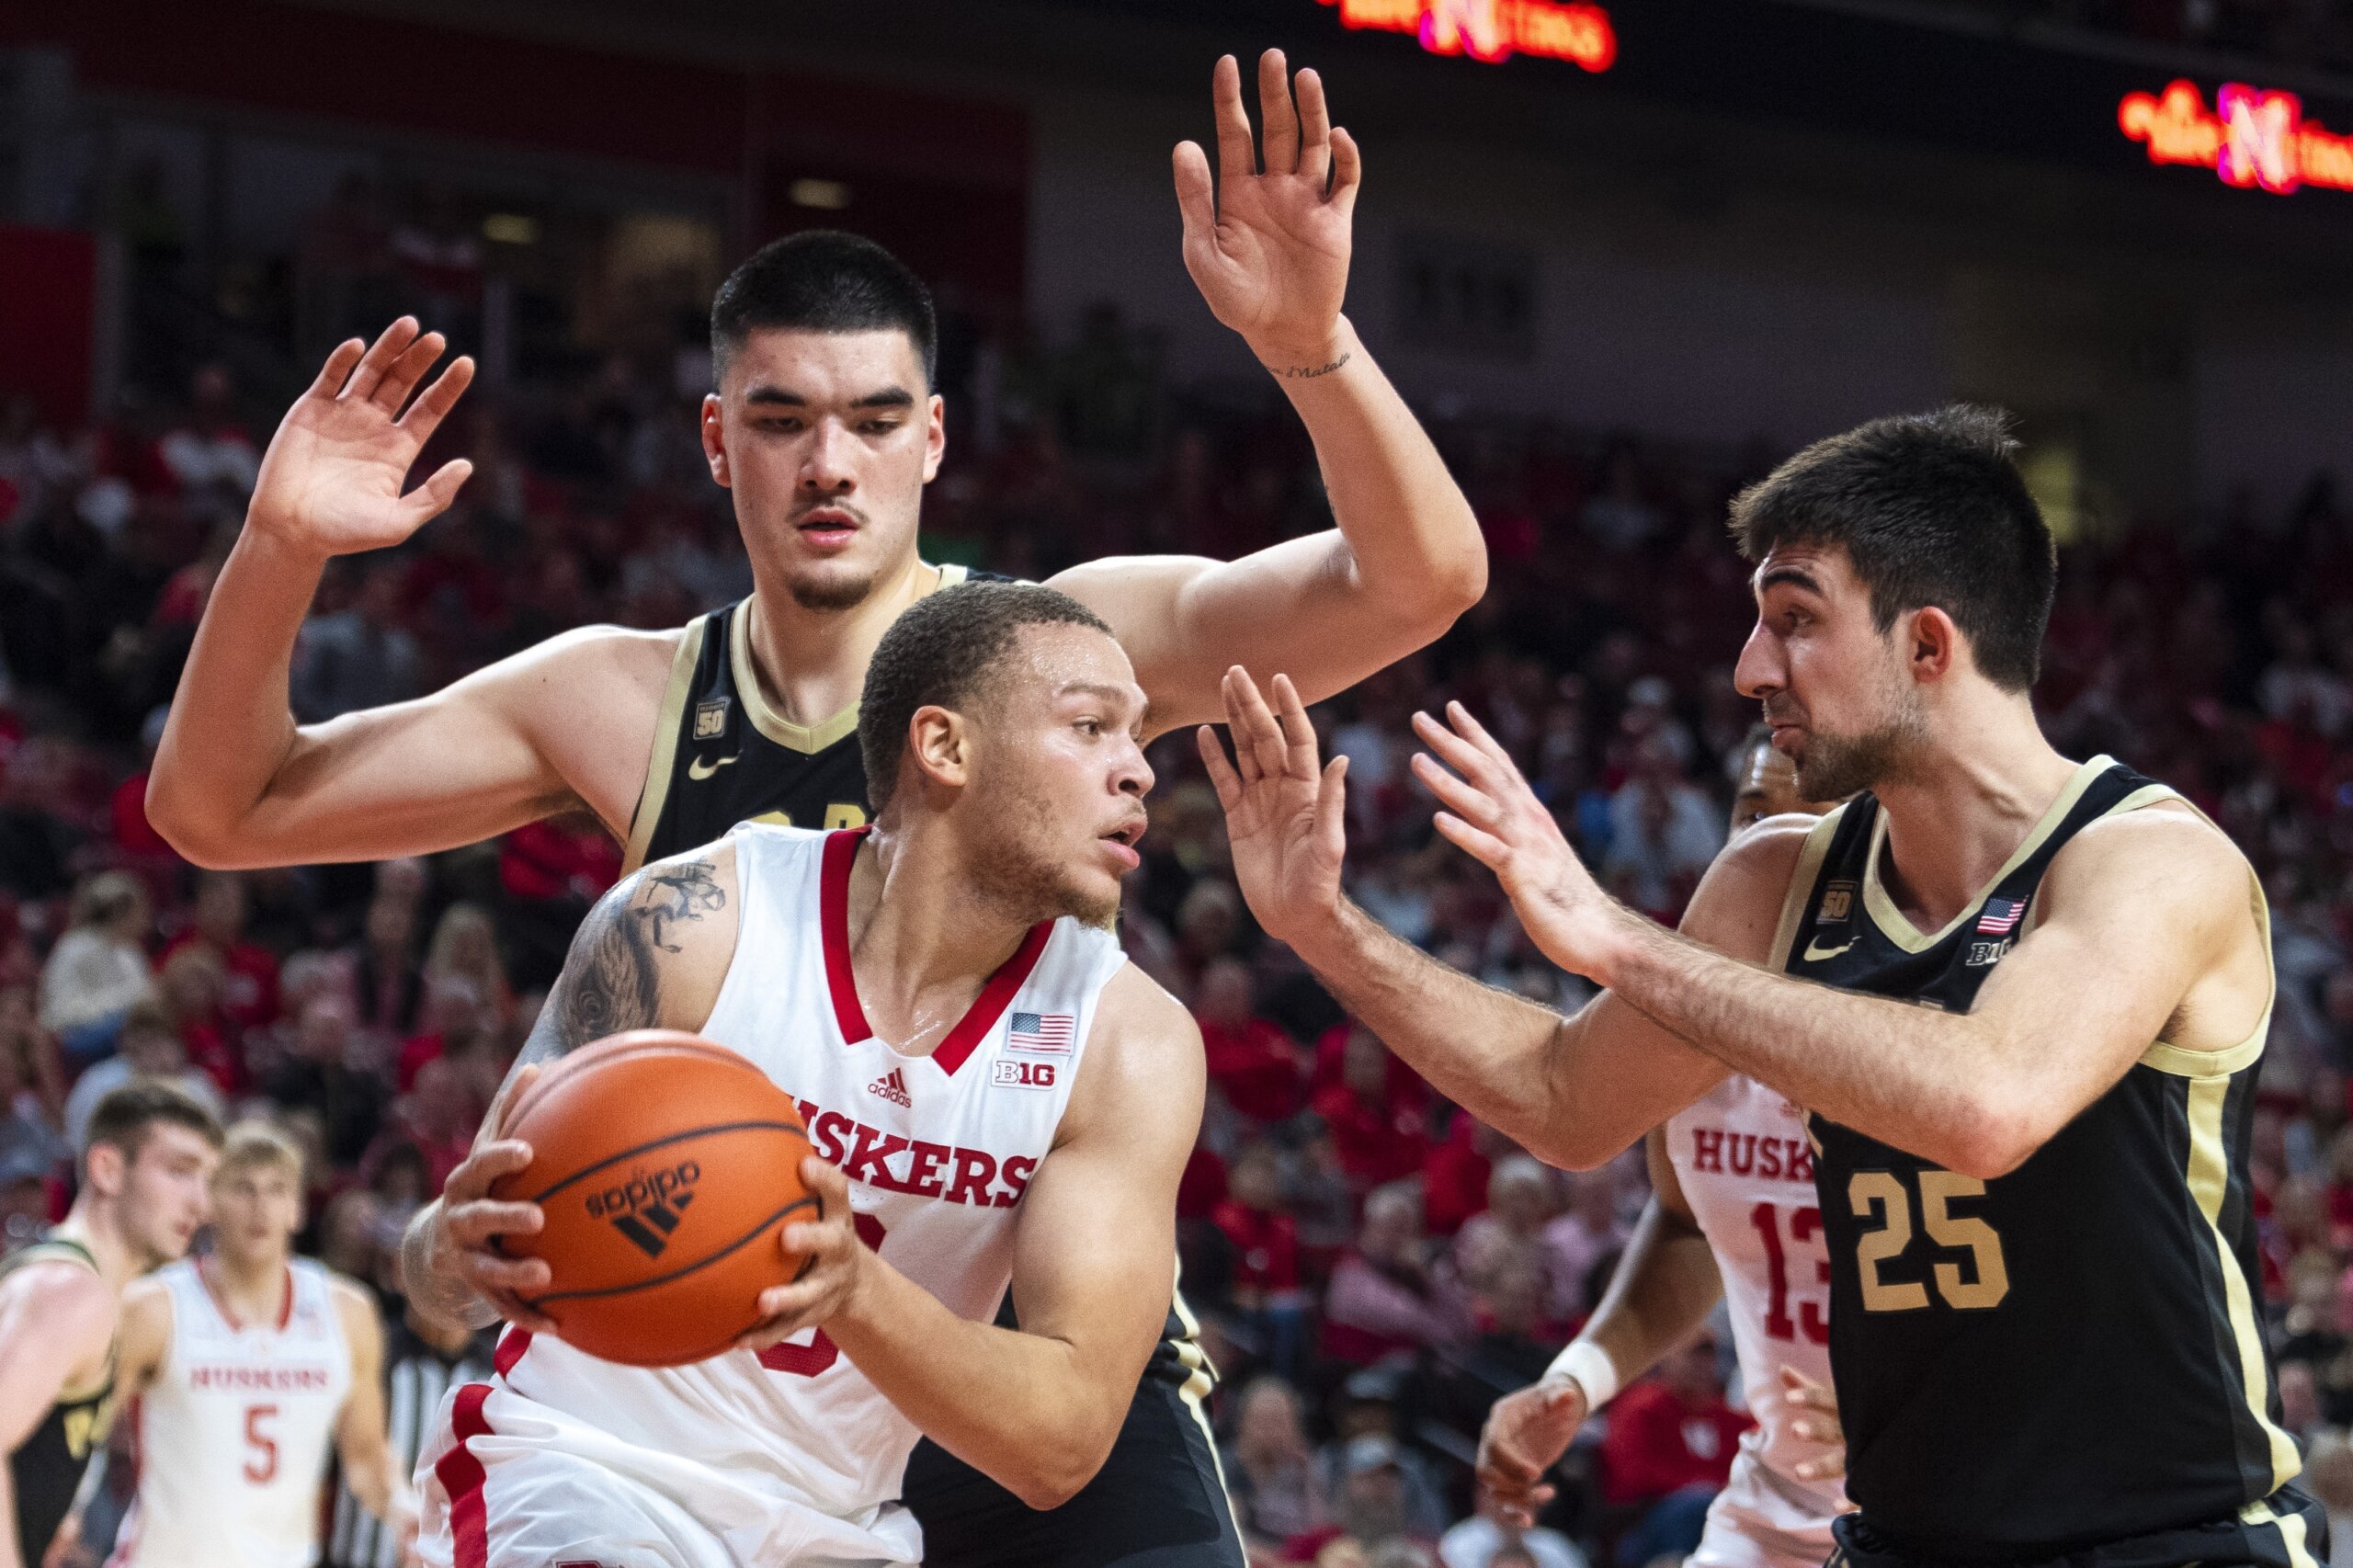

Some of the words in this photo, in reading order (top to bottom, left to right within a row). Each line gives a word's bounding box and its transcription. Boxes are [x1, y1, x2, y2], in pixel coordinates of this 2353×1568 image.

[697, 710, 723, 736] 50
[868, 1081, 912, 1108] adidas
[1847, 1170, 2010, 1312] 25
[244, 1404, 279, 1485] 5
